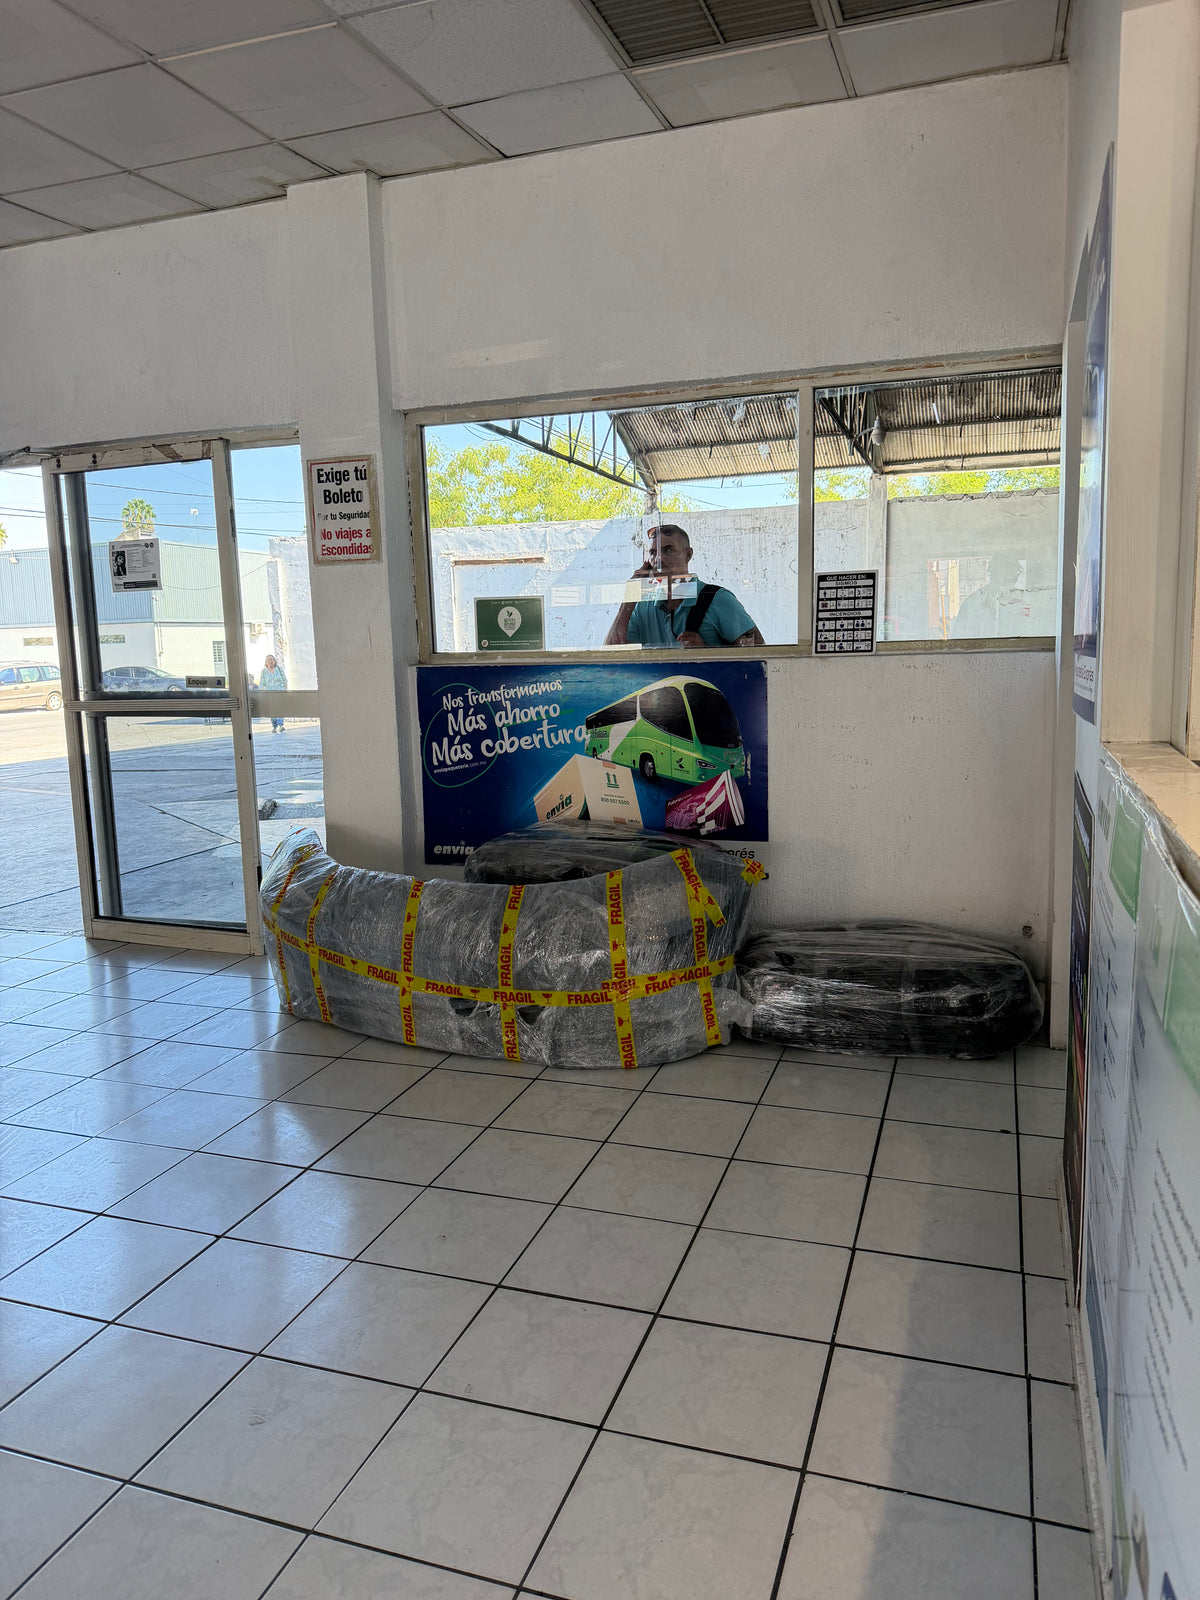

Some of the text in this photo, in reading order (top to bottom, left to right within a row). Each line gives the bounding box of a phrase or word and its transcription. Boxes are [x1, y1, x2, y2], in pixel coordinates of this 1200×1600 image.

[317, 465, 367, 486] Exige tú
[323, 488, 363, 505] Boleto
[321, 528, 372, 542] No viajes a
[321, 542, 374, 557] Escondidas
[188, 678, 208, 686] Empuje
[442, 679, 563, 711] Nos transformamos
[447, 701, 560, 736] Más ahorro
[431, 719, 590, 766] Más cobertura
[610, 883, 623, 925] FRAGIL
[280, 931, 302, 948] FRAGIL
[403, 931, 414, 973] FRAGIL
[693, 917, 706, 962] FRAGIL
[318, 949, 346, 967] FRAGIL
[500, 943, 512, 987] FRAGIL
[367, 966, 399, 984] FRAGIL
[425, 981, 463, 997] FRAGIL
[494, 991, 535, 1004] FRAGIL
[567, 991, 612, 1005] FRAGIL
[316, 985, 330, 1023] FRAGIL
[702, 992, 716, 1030] FRAGIL
[403, 1005, 415, 1044] FRAGIL
[504, 1017, 518, 1060] FRAGIL
